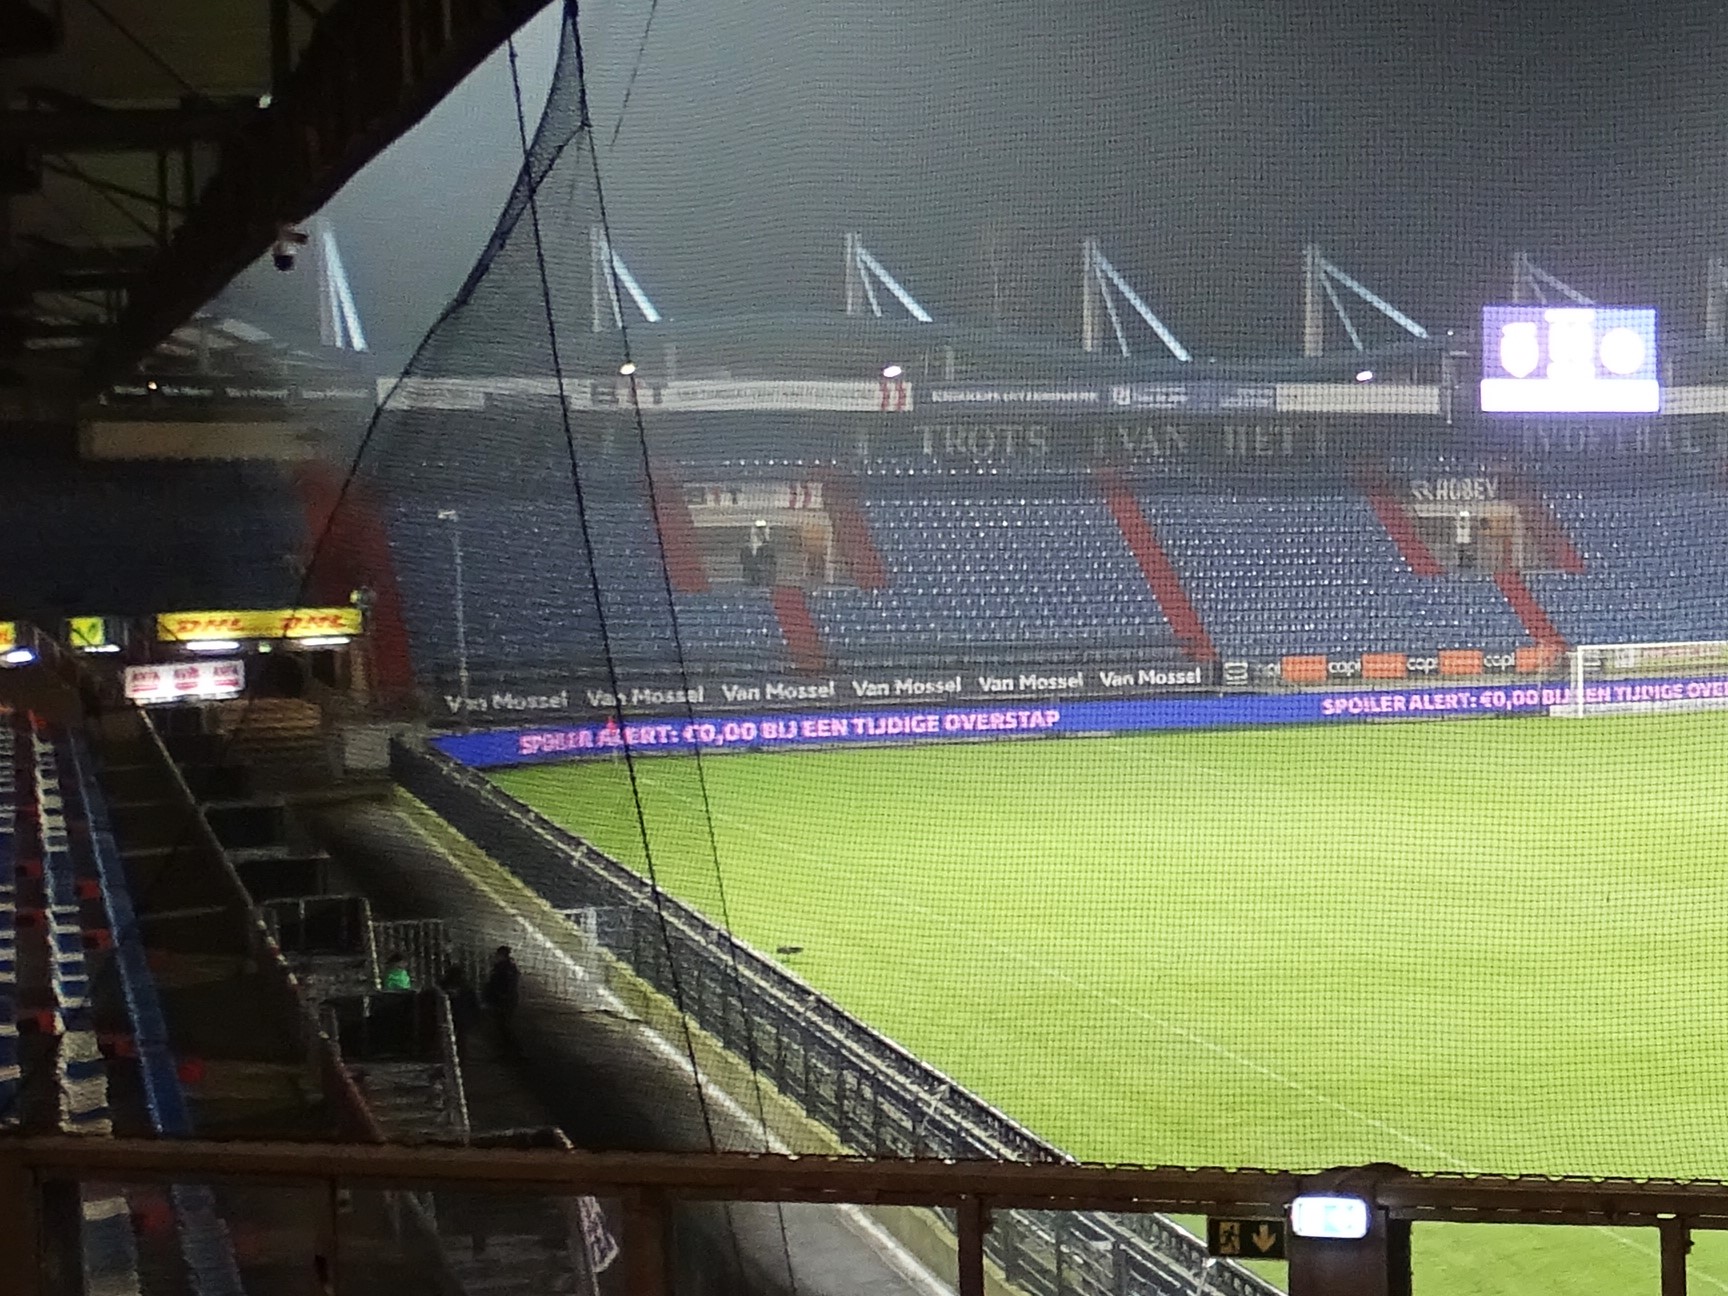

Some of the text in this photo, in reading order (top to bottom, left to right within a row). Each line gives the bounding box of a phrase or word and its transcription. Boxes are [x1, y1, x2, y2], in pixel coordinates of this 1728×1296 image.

[852, 675, 962, 698] Van Mossel
[978, 671, 1084, 693] Van Mossel
[1099, 667, 1201, 688] Van Mossel
[586, 685, 704, 707] Van Mossel
[722, 680, 835, 702] Van Mossel
[1321, 695, 1408, 715] SPOILER
[1410, 693, 1478, 712] ALERT:
[801, 717, 847, 738] EEN
[944, 710, 1061, 732] OVERSTAP
